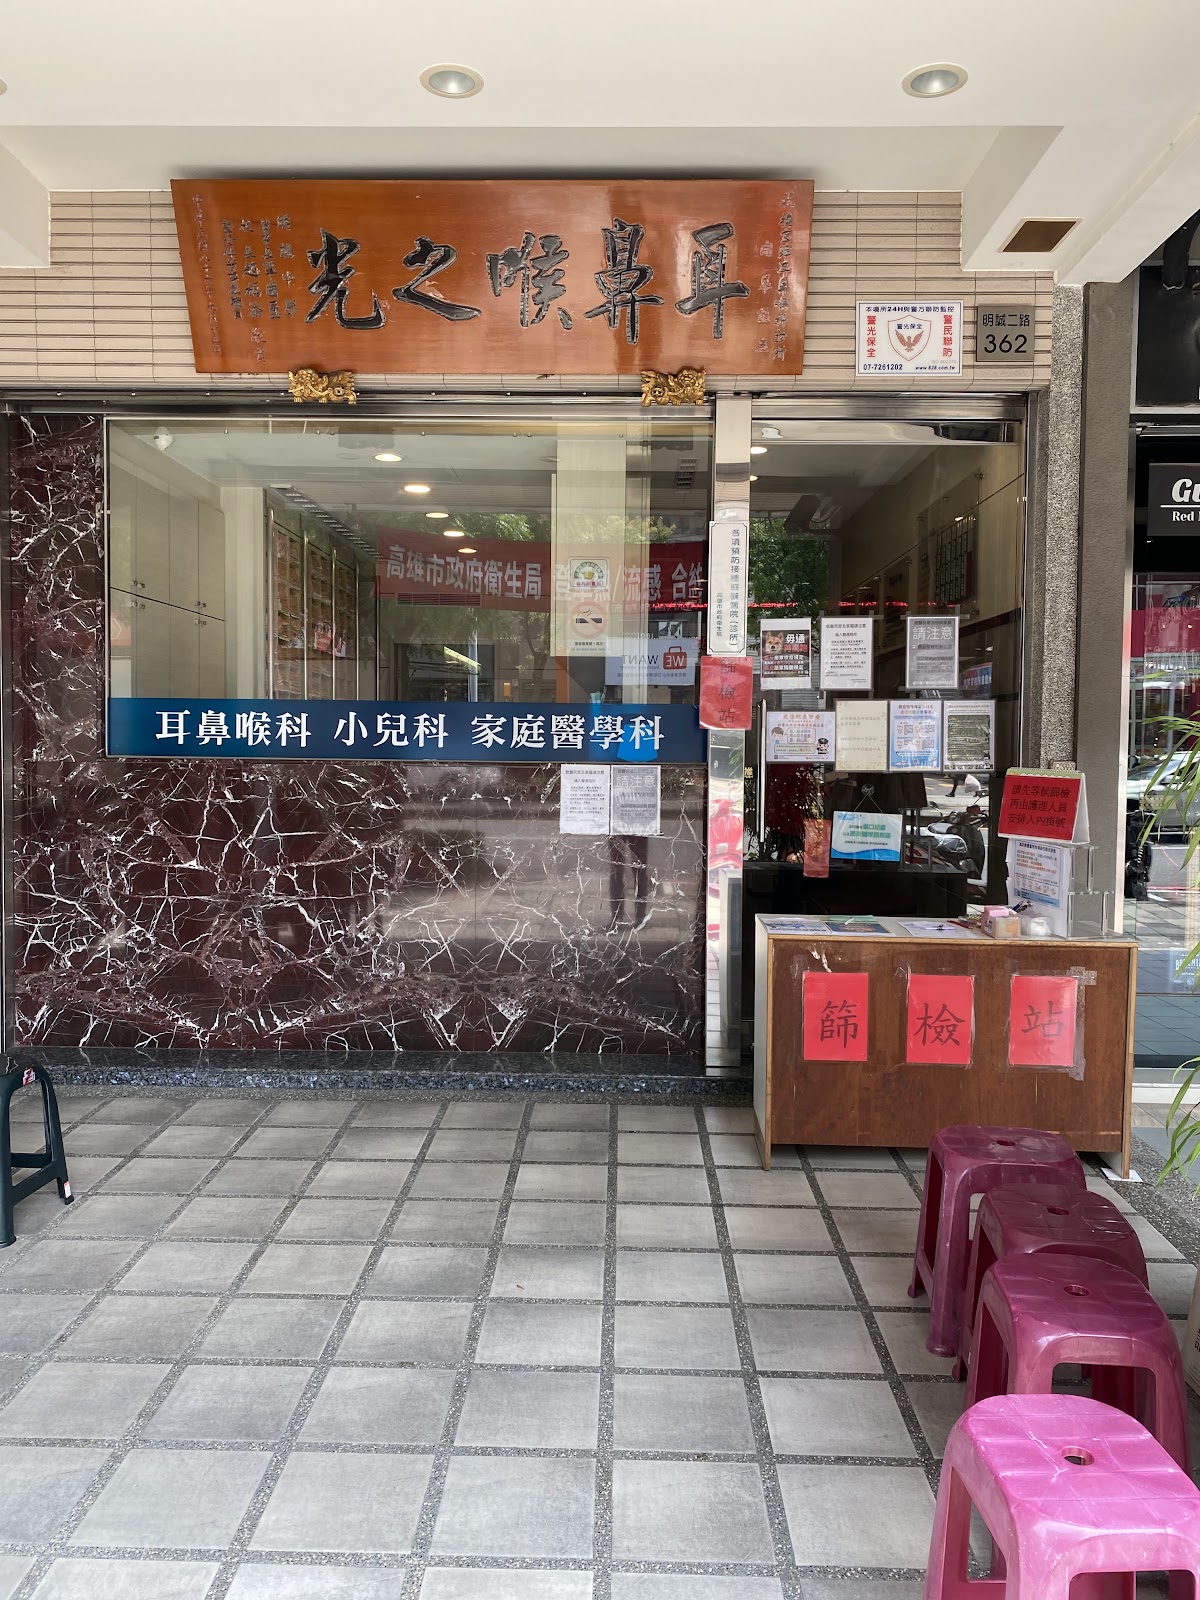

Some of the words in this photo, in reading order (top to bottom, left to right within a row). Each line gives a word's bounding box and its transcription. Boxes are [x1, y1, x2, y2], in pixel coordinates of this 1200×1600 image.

[982, 313, 1031, 328] 明誠二路
[866, 315, 877, 358] 警光保全
[942, 314, 953, 357] 警民聯防
[984, 334, 1028, 354] 362
[1172, 510, 1195, 522] Red
[386, 544, 542, 601] 高雄市政府衛生局
[786, 634, 805, 644] 毋通
[912, 627, 953, 640] 請注意
[155, 709, 311, 747] 耳鼻喉科
[333, 711, 450, 749] 小兒科
[470, 713, 665, 751] 家庭醫學科
[616, 775, 656, 788] 請注意
[1012, 784, 1070, 798] 請先等候篩檢
[1010, 798, 1067, 812] 再由護理人員
[819, 999, 859, 1049] 篩
[913, 1003, 966, 1047] 檢
[1021, 1000, 1063, 1039] 站
